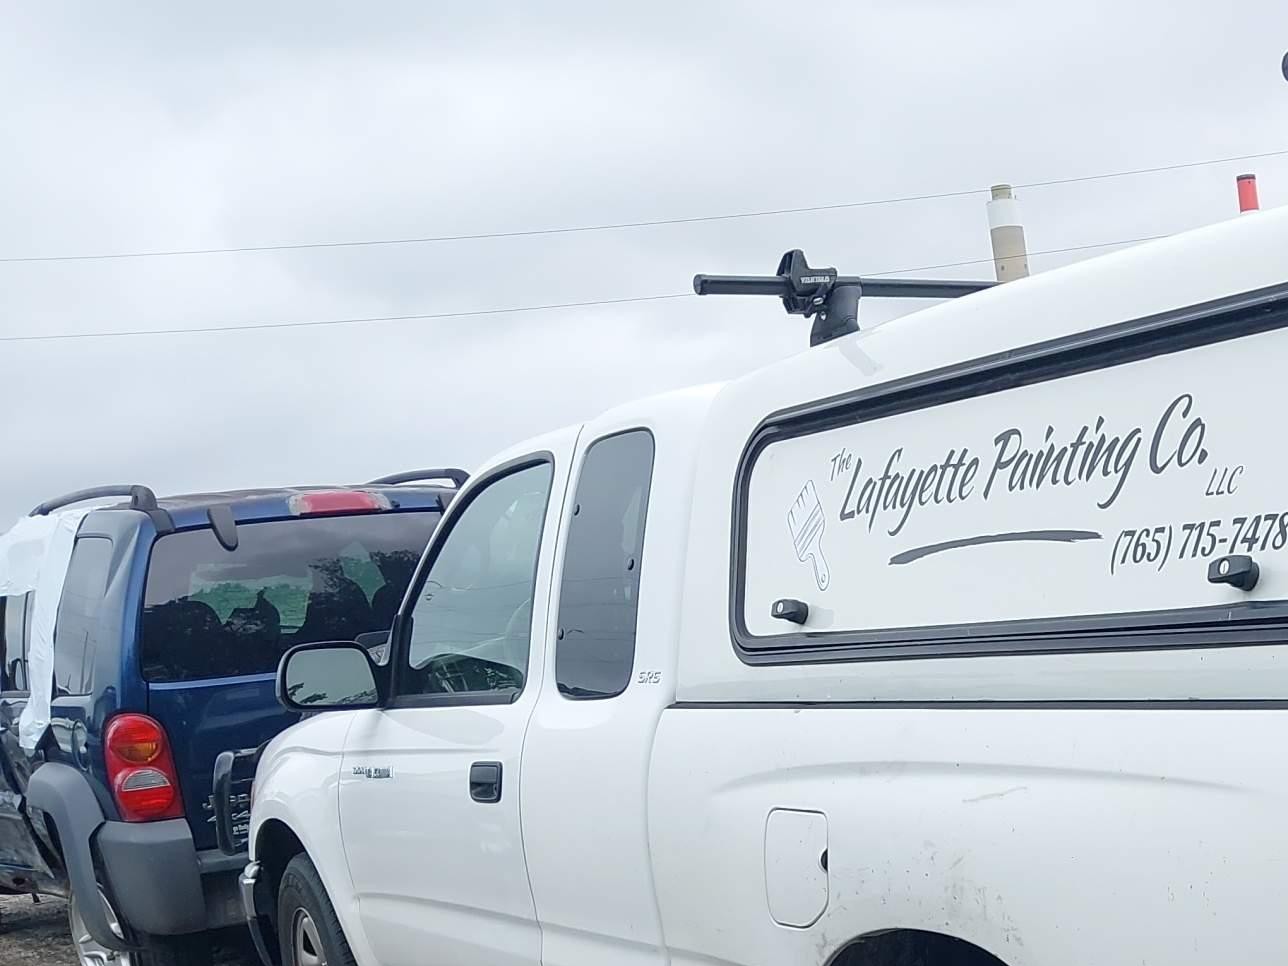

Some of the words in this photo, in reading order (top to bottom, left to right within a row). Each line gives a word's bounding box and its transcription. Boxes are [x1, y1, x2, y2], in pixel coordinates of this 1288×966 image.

[830, 447, 852, 482] The
[983, 416, 1141, 509] Painting
[1150, 394, 1208, 474] Co.
[839, 448, 979, 536] Lafayette
[1205, 465, 1244, 497] LLC
[1111, 522, 1172, 575] (765)
